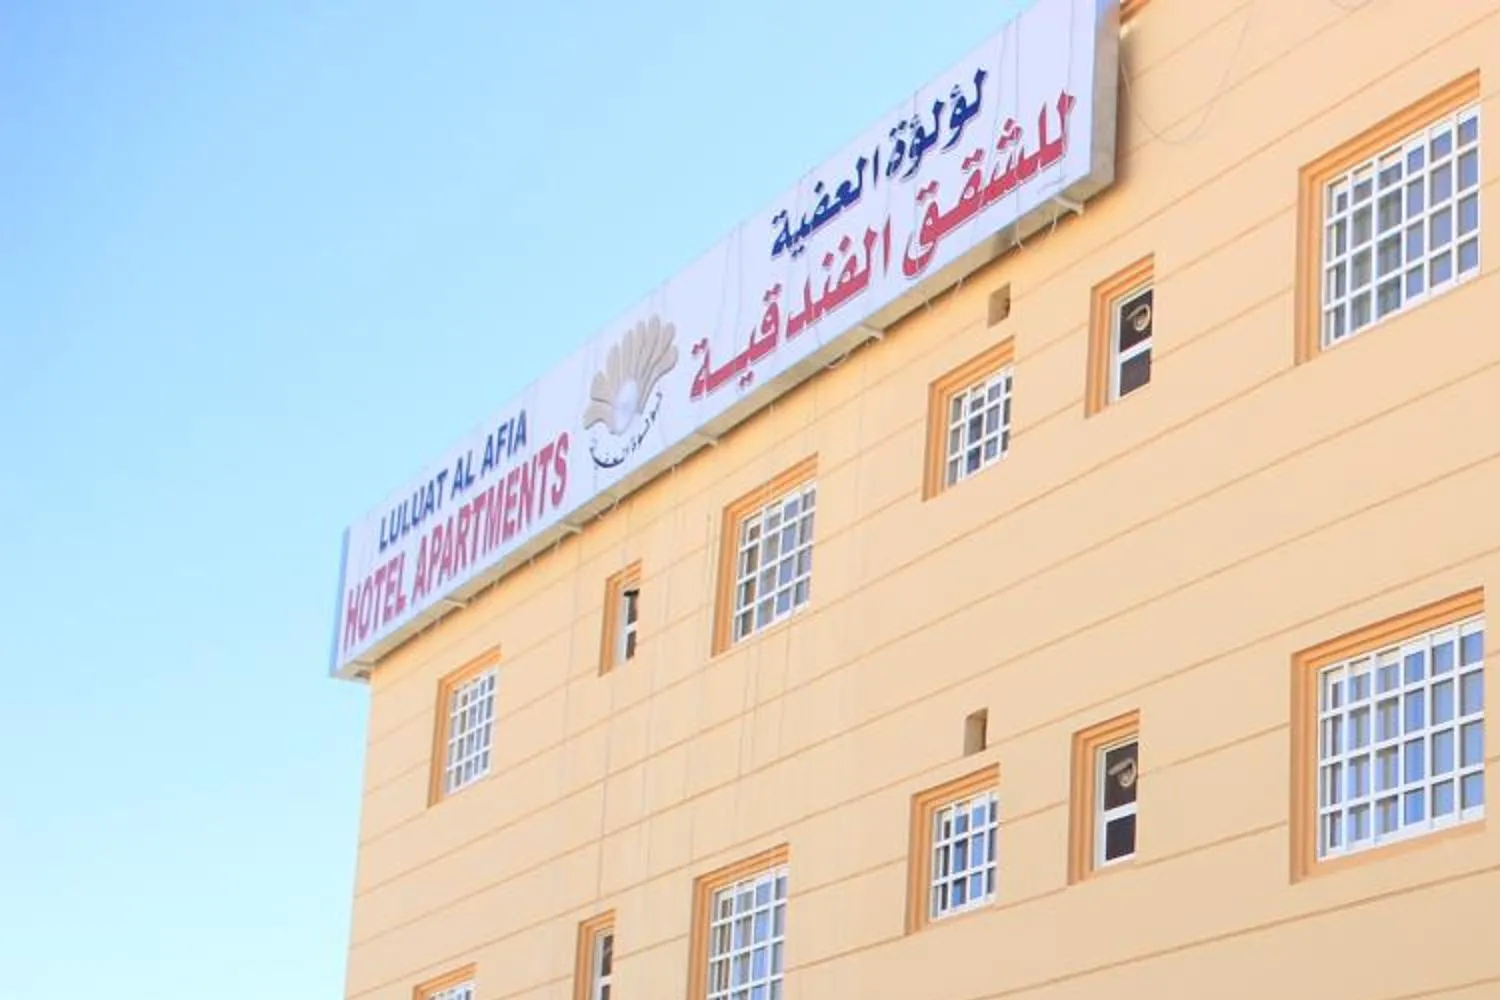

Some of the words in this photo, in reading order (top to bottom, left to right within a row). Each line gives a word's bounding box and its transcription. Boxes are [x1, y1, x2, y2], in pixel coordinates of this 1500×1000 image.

[771, 145, 880, 259] العفية
[887, 67, 988, 180] لؤلؤة
[903, 90, 1076, 277] للشقق
[690, 215, 892, 400] الفندقية
[344, 550, 407, 653] HOTEL
[411, 431, 569, 607] APARTMENTS
[379, 468, 448, 552] LULUAT
[451, 450, 475, 500] AL
[481, 409, 527, 479] AFIA
